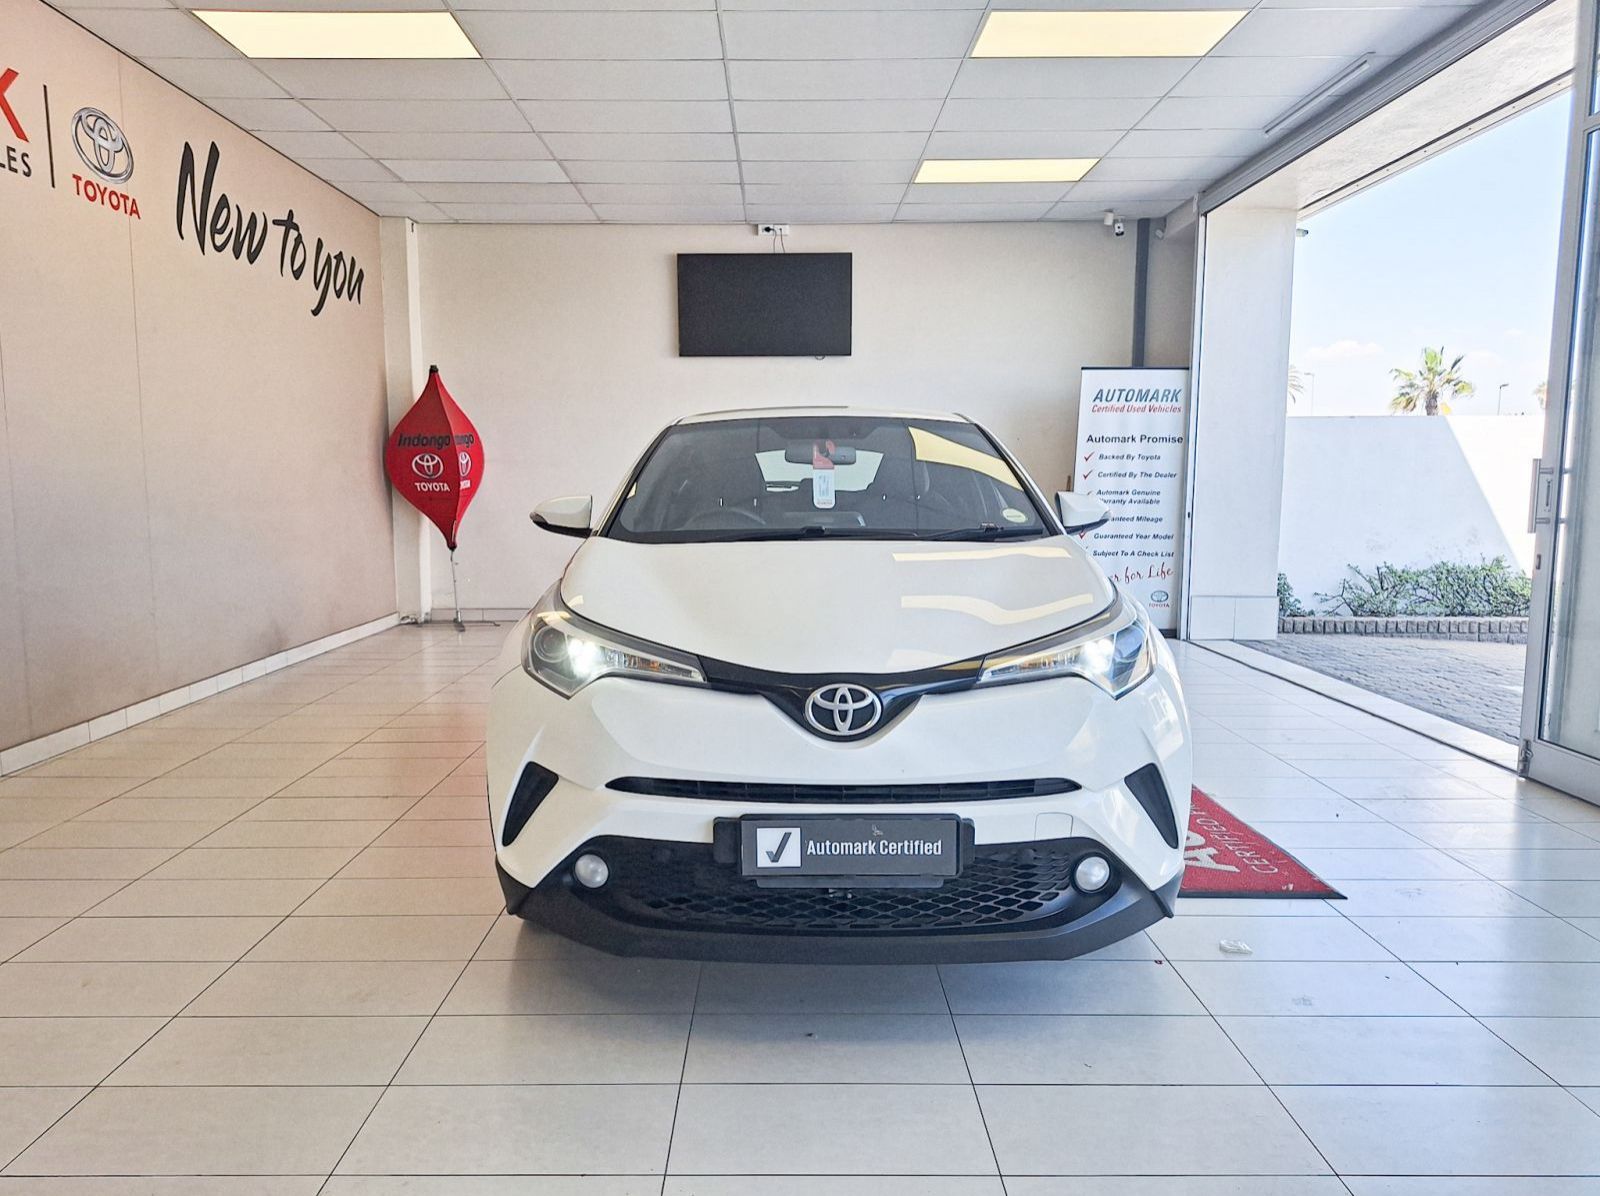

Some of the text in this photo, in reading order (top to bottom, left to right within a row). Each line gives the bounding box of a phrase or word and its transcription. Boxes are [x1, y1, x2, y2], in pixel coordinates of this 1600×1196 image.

[72, 173, 141, 220] TOYOTA
[176, 141, 365, 317] New to you
[1092, 388, 1182, 403] AUTOMARK
[1091, 404, 1182, 414] Certified Used Vehicles
[398, 432, 451, 450] Indongo
[1086, 434, 1184, 444] Automark Promise
[1098, 453, 1161, 461] Backed By Toyota
[1097, 471, 1177, 479] Certified By The Dealer
[415, 482, 451, 492] TOYOTA
[1131, 489, 1161, 497] Genuine
[1100, 498, 1127, 506] arranty
[1135, 515, 1164, 524] Mileage
[1093, 532, 1174, 540] Guaranteed Year Model
[1092, 550, 1175, 559] Subject To A Check List
[1124, 565, 1144, 585] for
[1147, 561, 1174, 580] Life
[806, 839, 943, 856] Automark Certified
